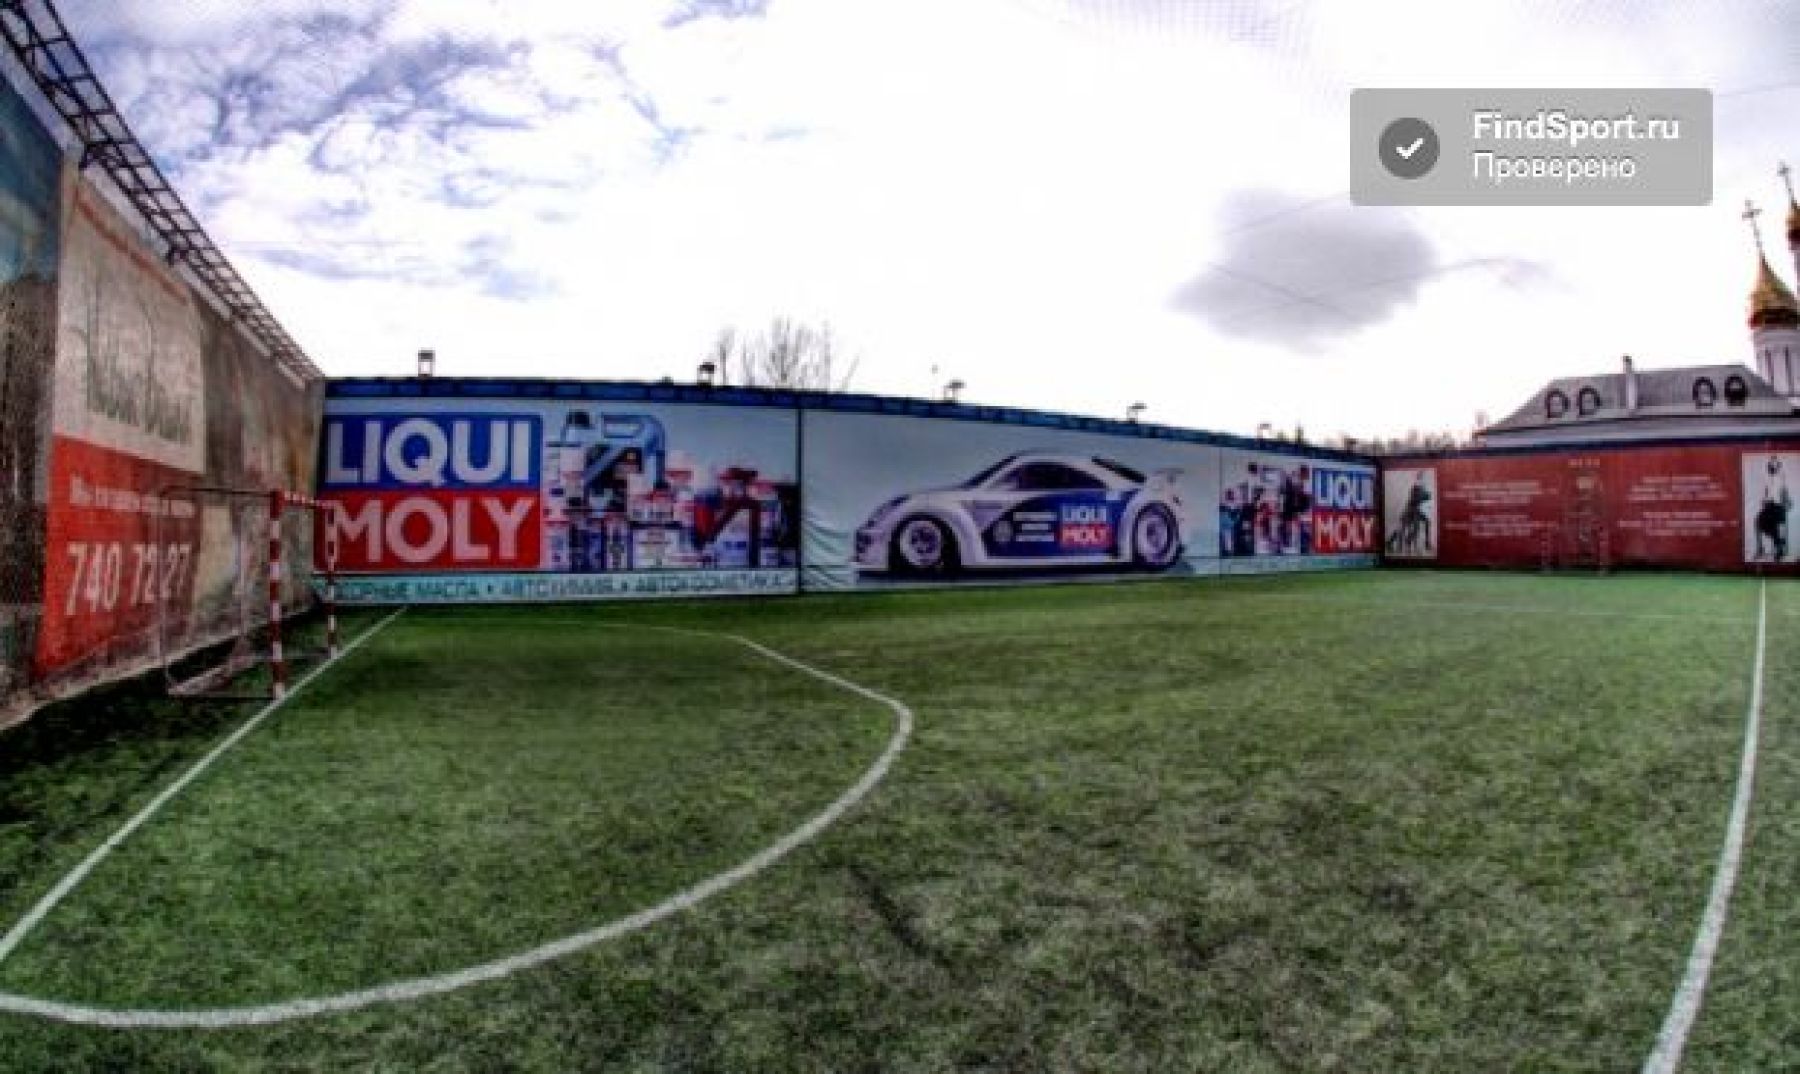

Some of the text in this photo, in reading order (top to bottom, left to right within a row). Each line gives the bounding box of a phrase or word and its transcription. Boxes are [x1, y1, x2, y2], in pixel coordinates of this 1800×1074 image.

[325, 418, 531, 486] LIQUI
[322, 497, 536, 563] MOLY
[1316, 513, 1375, 550] MOLY
[66, 542, 120, 615] 740
[130, 542, 157, 606] 72
